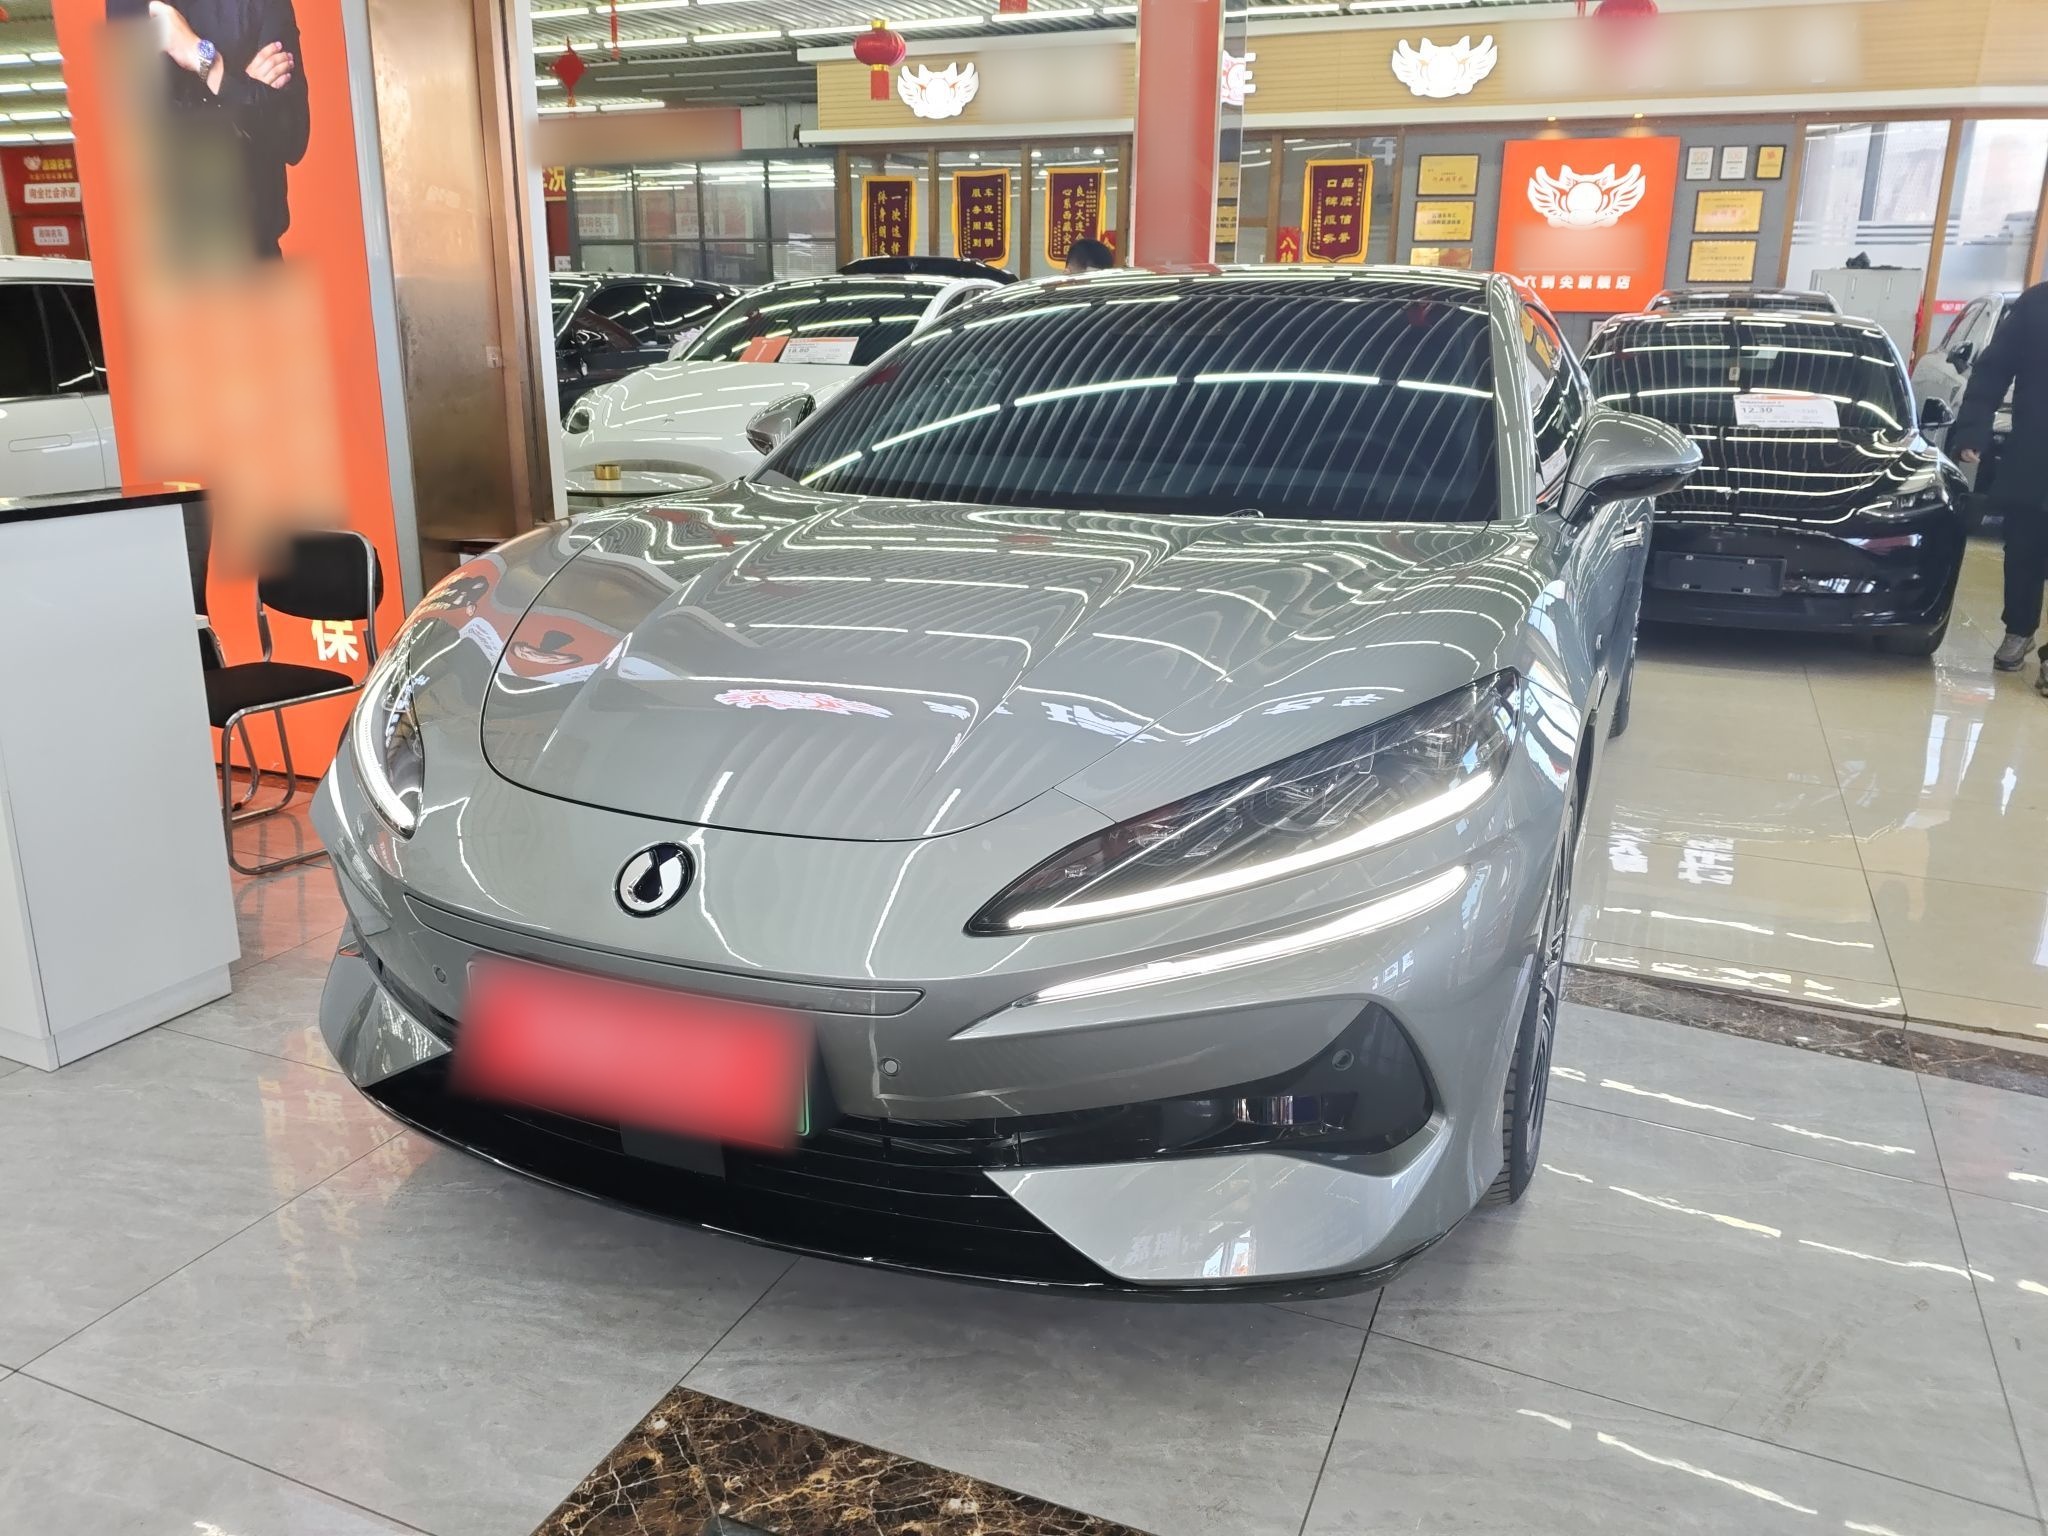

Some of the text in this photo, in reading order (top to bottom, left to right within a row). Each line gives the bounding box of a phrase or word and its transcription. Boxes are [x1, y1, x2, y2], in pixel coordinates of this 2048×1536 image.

[543, 165, 567, 193] 况
[971, 187, 982, 248] 服务周到
[983, 187, 994, 249] 车况透明
[1322, 178, 1339, 244] 口碑服务
[1338, 177, 1355, 243] 品质信誉
[311, 619, 359, 664] 保
